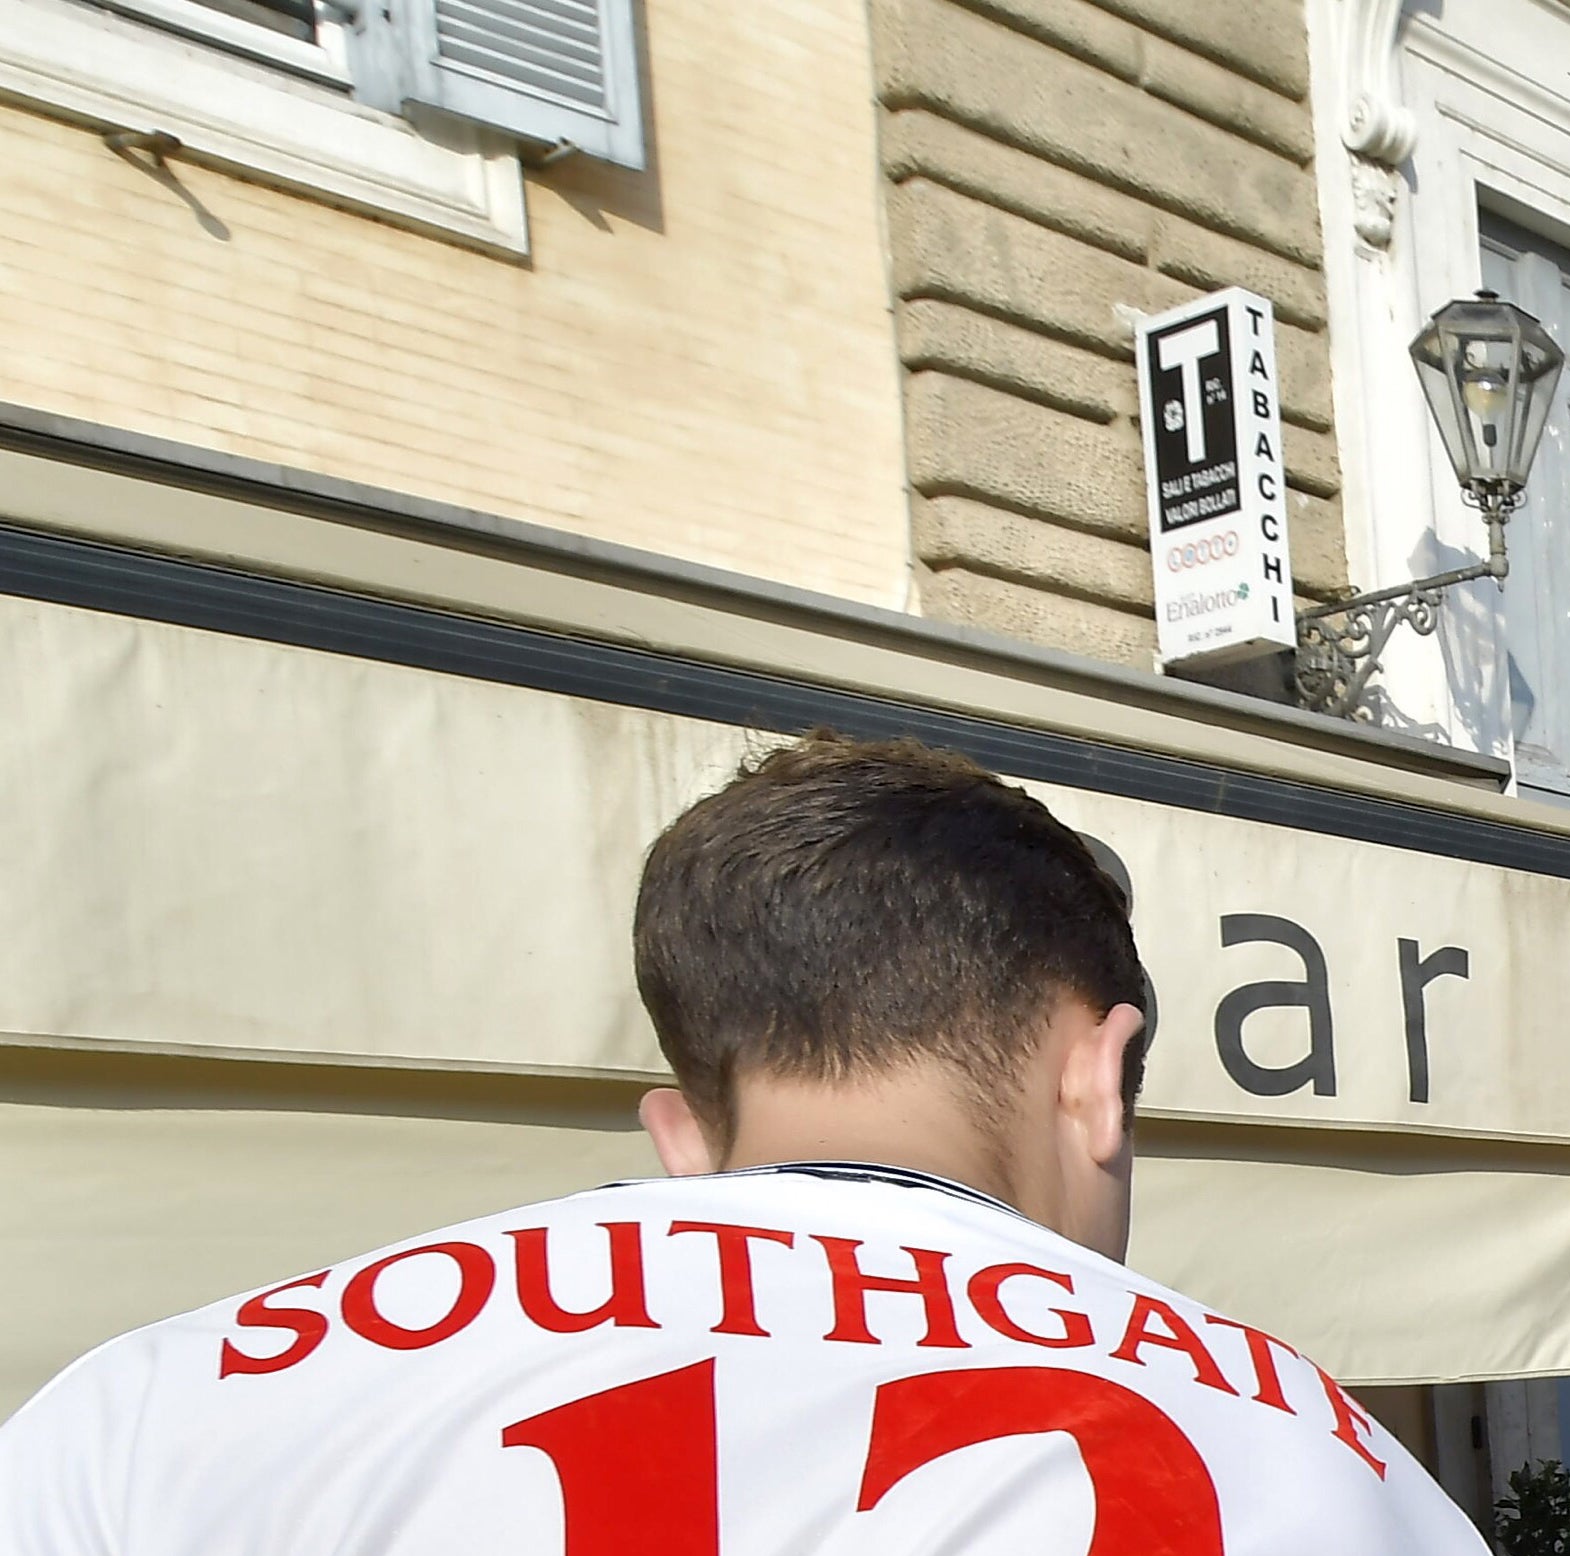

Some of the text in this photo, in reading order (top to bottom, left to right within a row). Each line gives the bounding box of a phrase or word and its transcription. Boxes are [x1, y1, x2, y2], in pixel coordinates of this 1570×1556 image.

[1157, 319, 1220, 464] T
[1244, 305, 1283, 623] TABACCHI
[218, 1220, 1388, 1482] SOUTHGATE
